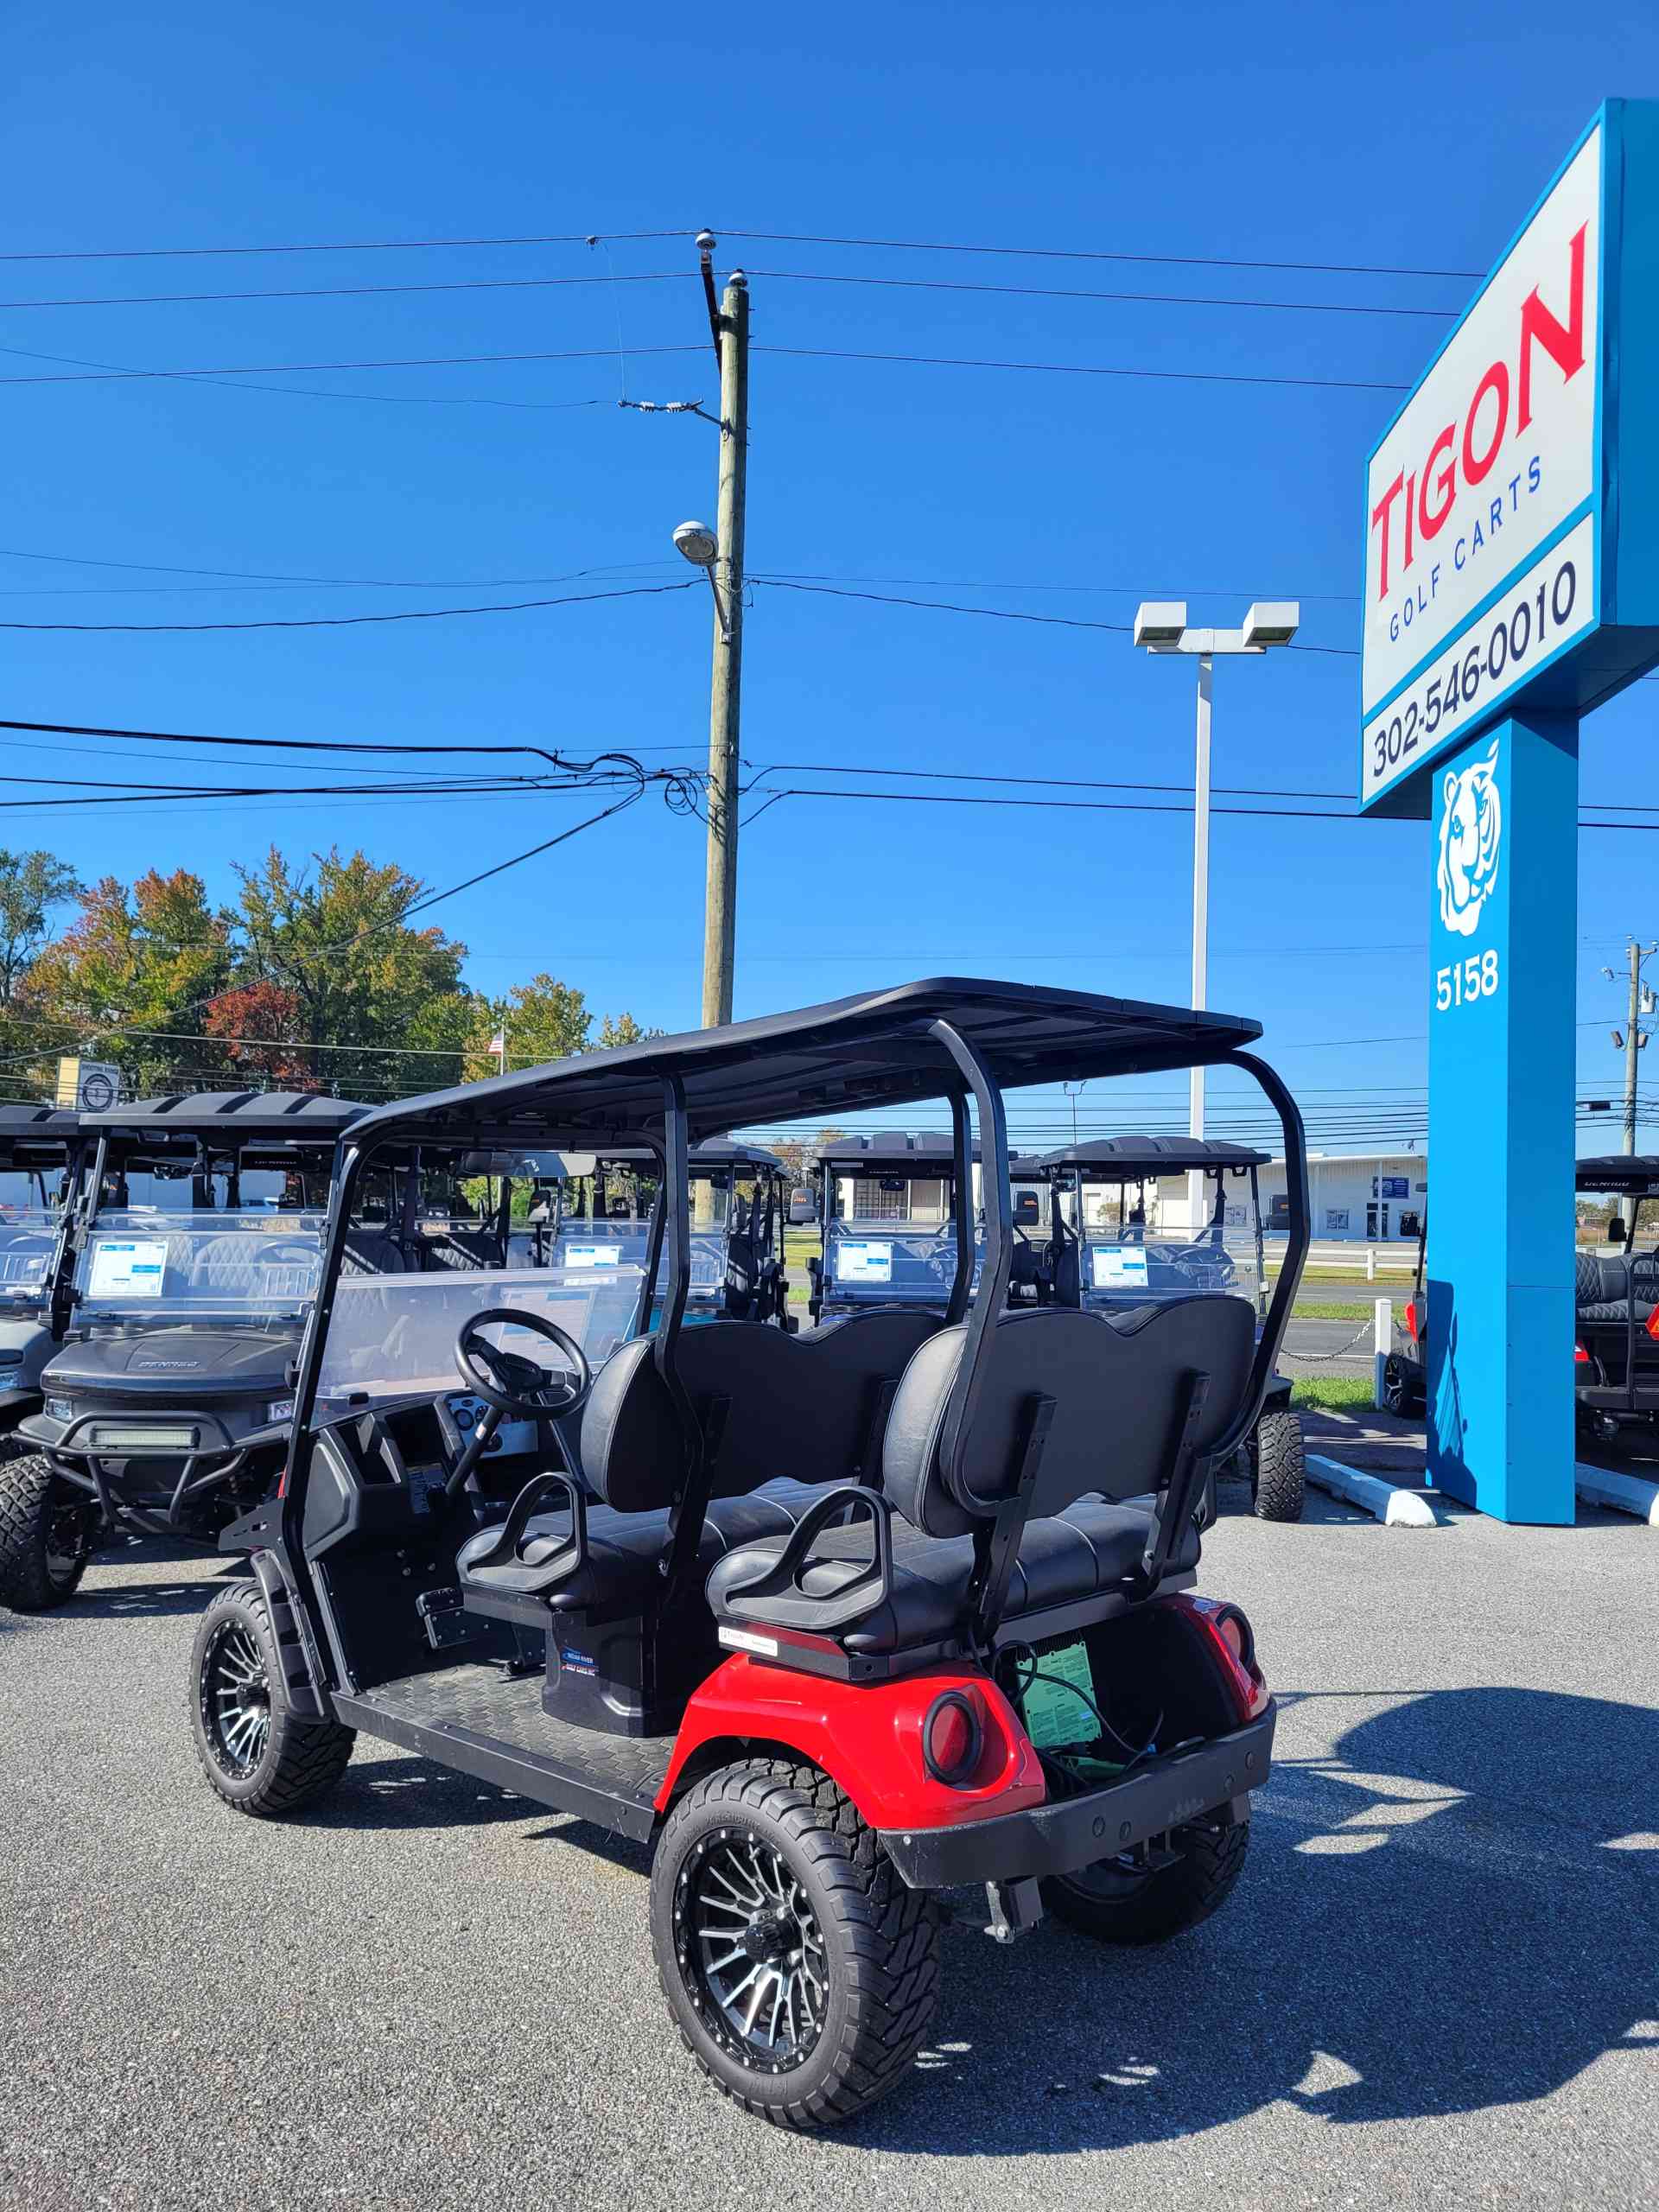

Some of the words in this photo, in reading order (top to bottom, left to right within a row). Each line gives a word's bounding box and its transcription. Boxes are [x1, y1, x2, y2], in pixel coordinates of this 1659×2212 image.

[1371, 219, 1588, 602] TIGON
[1389, 563, 1440, 643] GOLF
[1454, 455, 1541, 570] CARTS
[1374, 561, 1576, 779] 302-546-0010
[1436, 949, 1499, 1011] 5158
